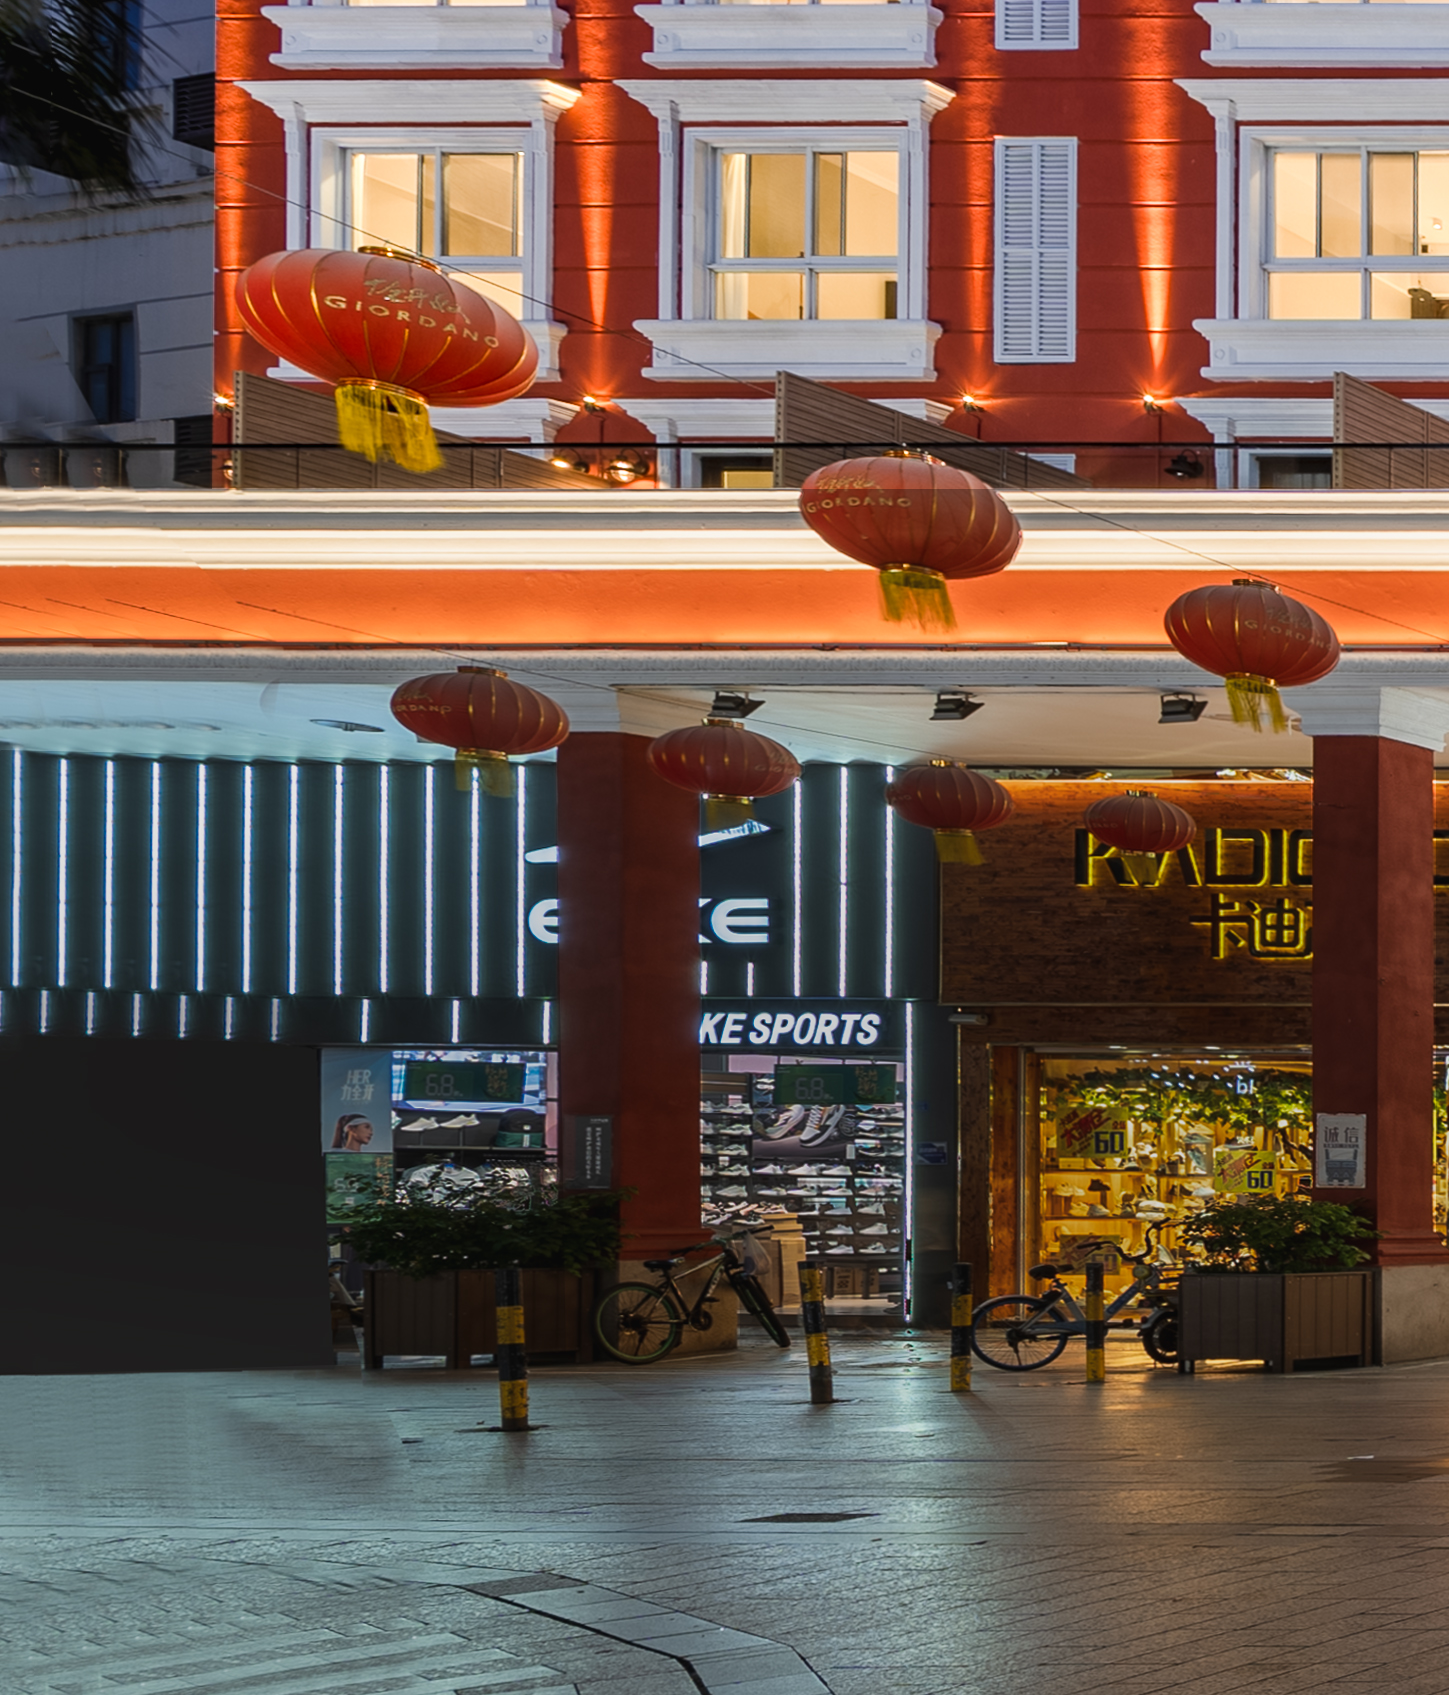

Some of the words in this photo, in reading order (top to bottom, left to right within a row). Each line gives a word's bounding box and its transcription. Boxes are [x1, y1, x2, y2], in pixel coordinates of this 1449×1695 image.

[324, 295, 499, 349] GIORDANO
[1189, 893, 1313, 960] 卡迪
[750, 1012, 881, 1046] SPORTS
[1324, 1126, 1359, 1143] 诚信
